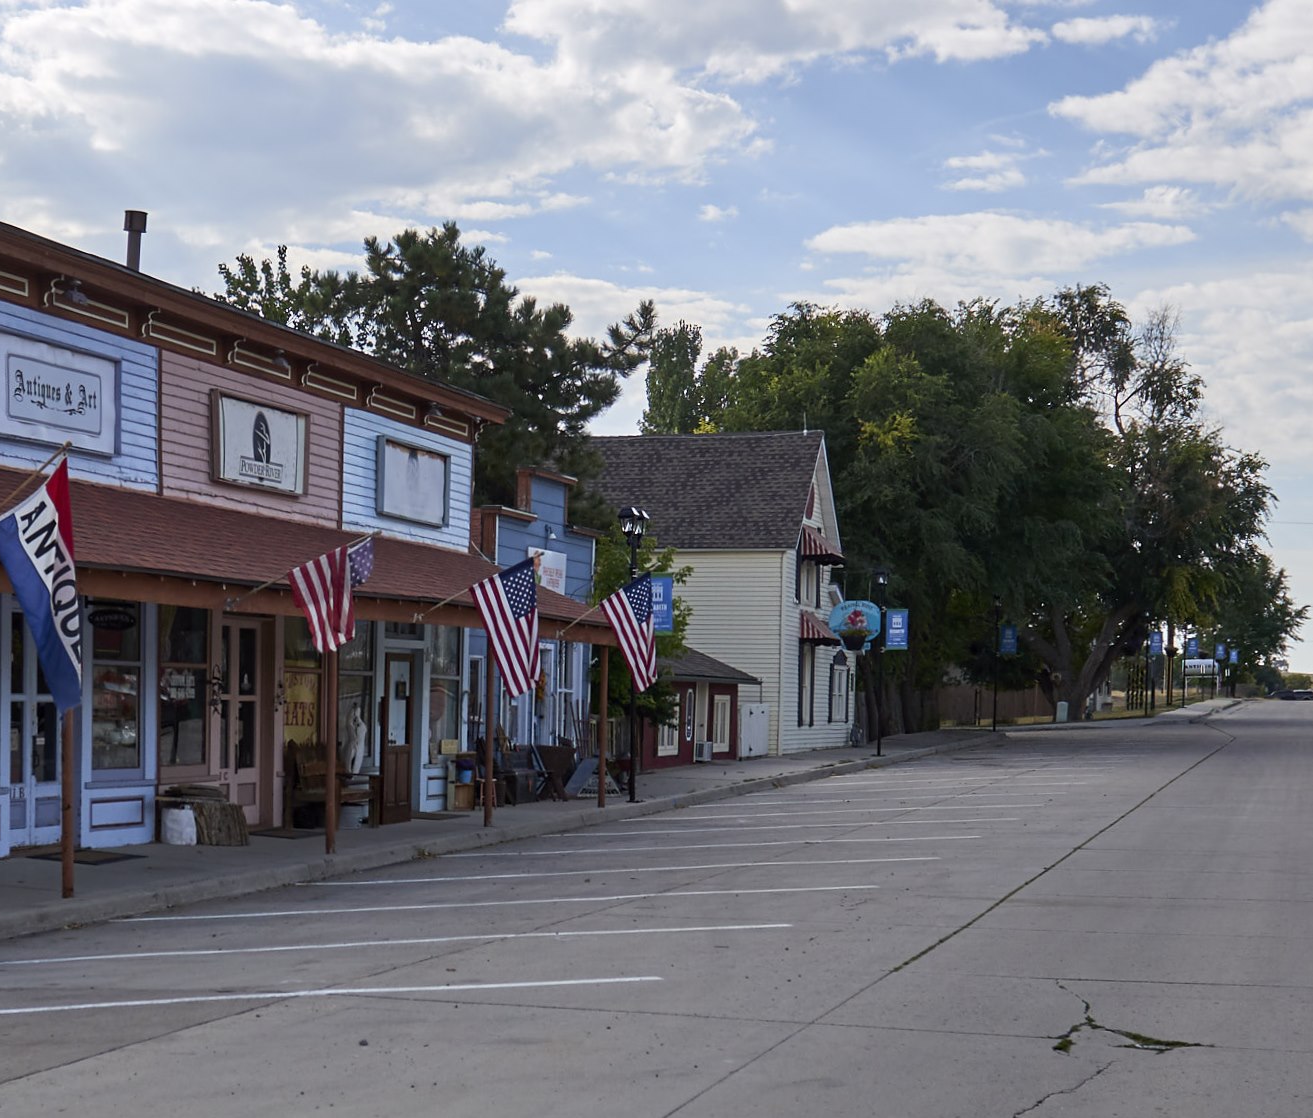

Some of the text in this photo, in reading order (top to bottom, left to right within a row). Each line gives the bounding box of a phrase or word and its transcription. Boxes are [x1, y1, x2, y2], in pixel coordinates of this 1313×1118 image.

[13, 369, 97, 415] Antiques & Art
